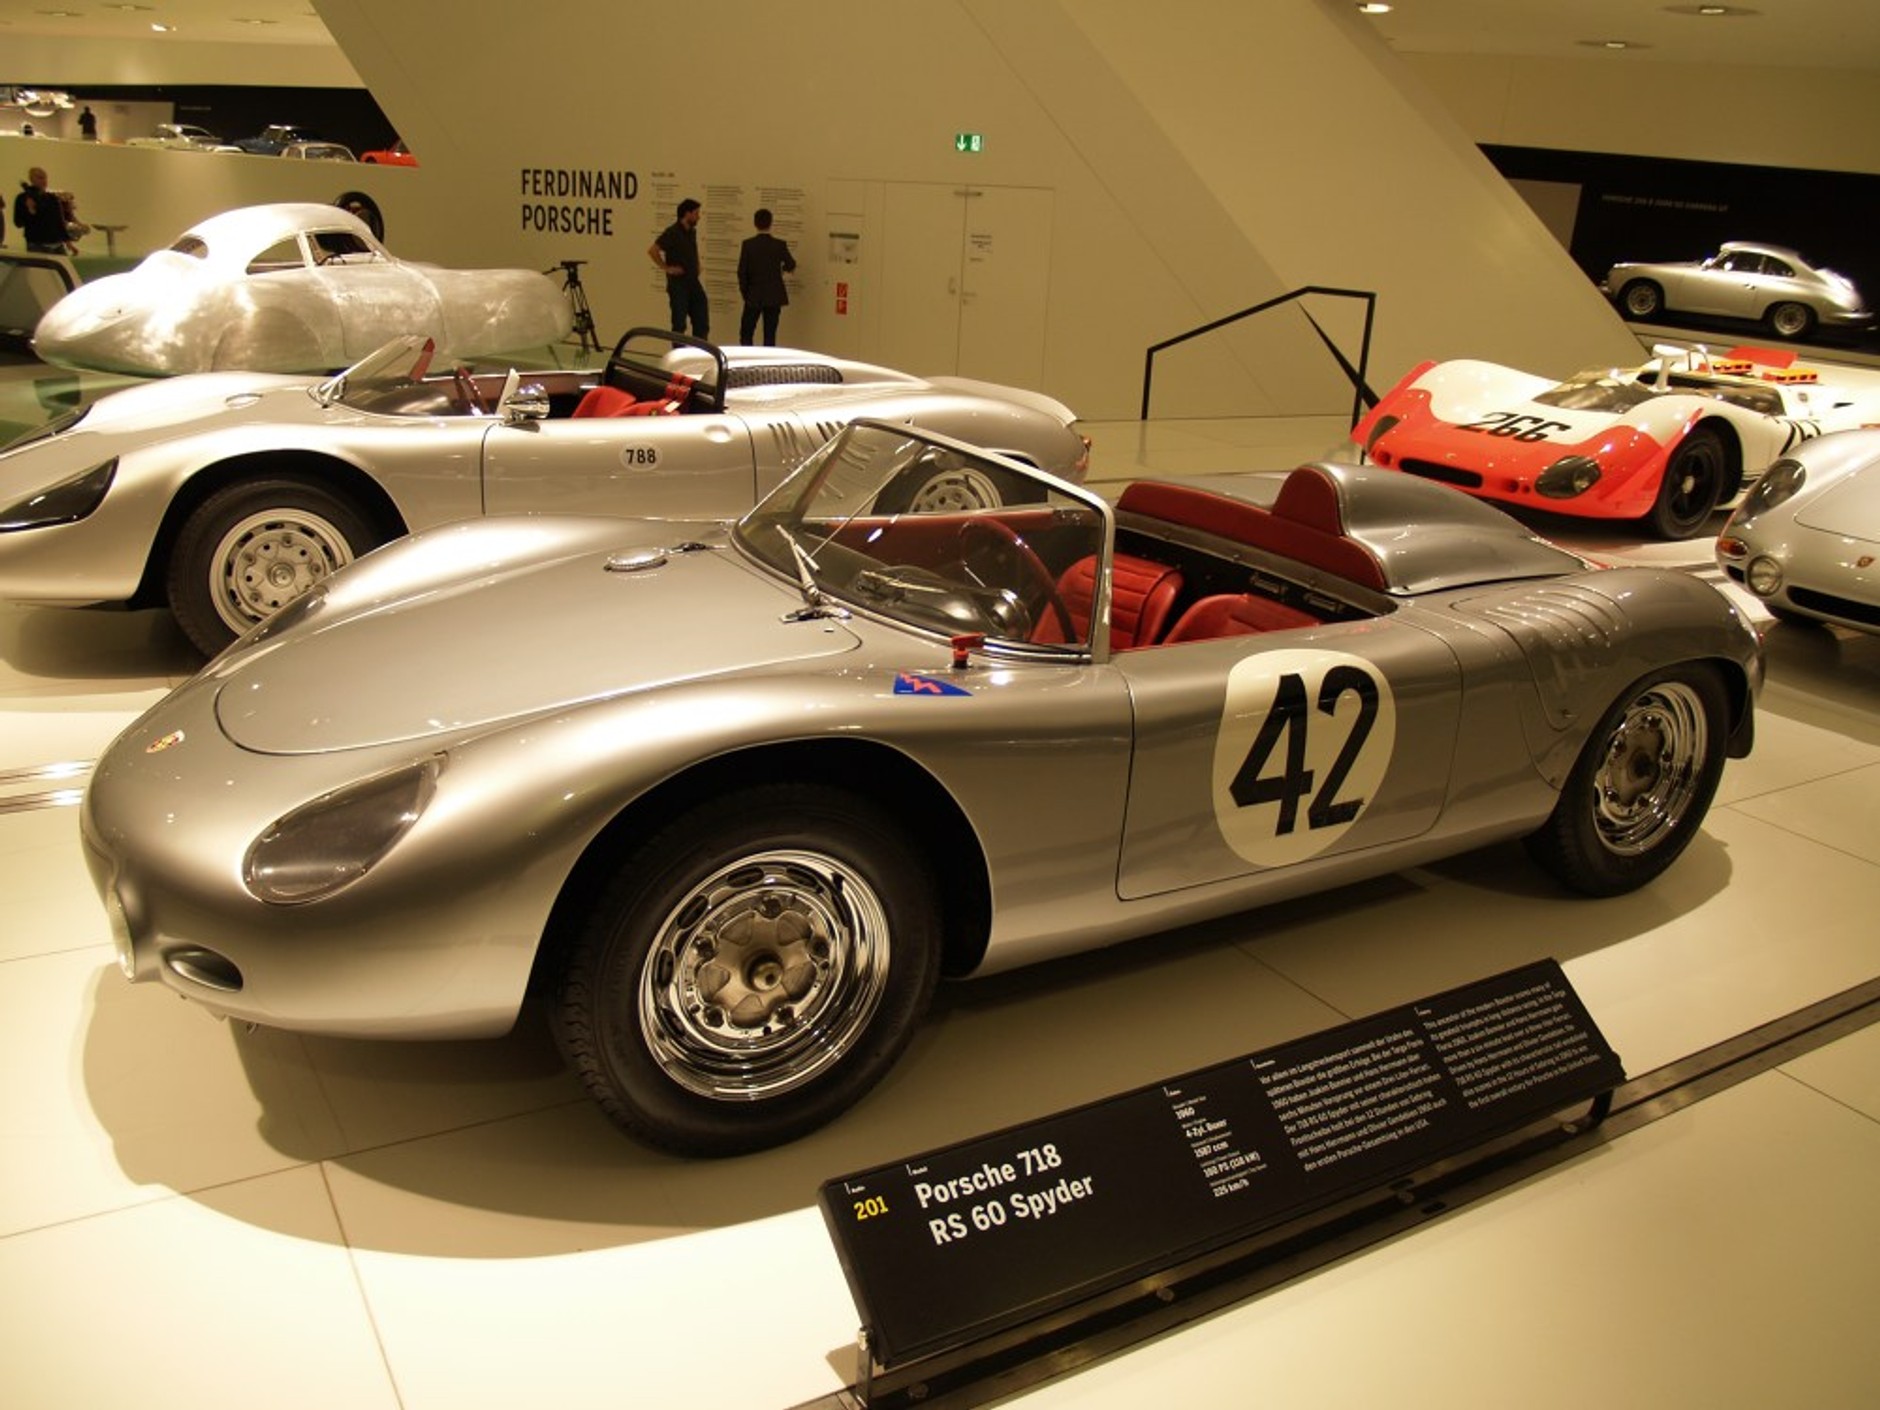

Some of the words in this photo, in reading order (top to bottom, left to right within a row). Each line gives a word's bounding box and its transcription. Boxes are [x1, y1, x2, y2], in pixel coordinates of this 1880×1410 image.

[521, 168, 638, 200] FERDINAND
[522, 204, 614, 236] PORSCHE
[1453, 412, 1572, 442] 266
[626, 448, 656, 465] 788
[1229, 665, 1380, 836] 42
[1175, 1106, 1195, 1120] 1960
[1206, 1119, 1227, 1131] Boxer
[914, 1162, 1017, 1208] Porsche
[1017, 1143, 1062, 1176] 718
[1218, 1162, 1230, 1172] PS
[1228, 1178, 1250, 1192] km/h
[853, 1195, 889, 1220] 201
[928, 1213, 968, 1245] RS
[971, 1200, 1006, 1231] 60
[1010, 1175, 1094, 1220] Spyder
